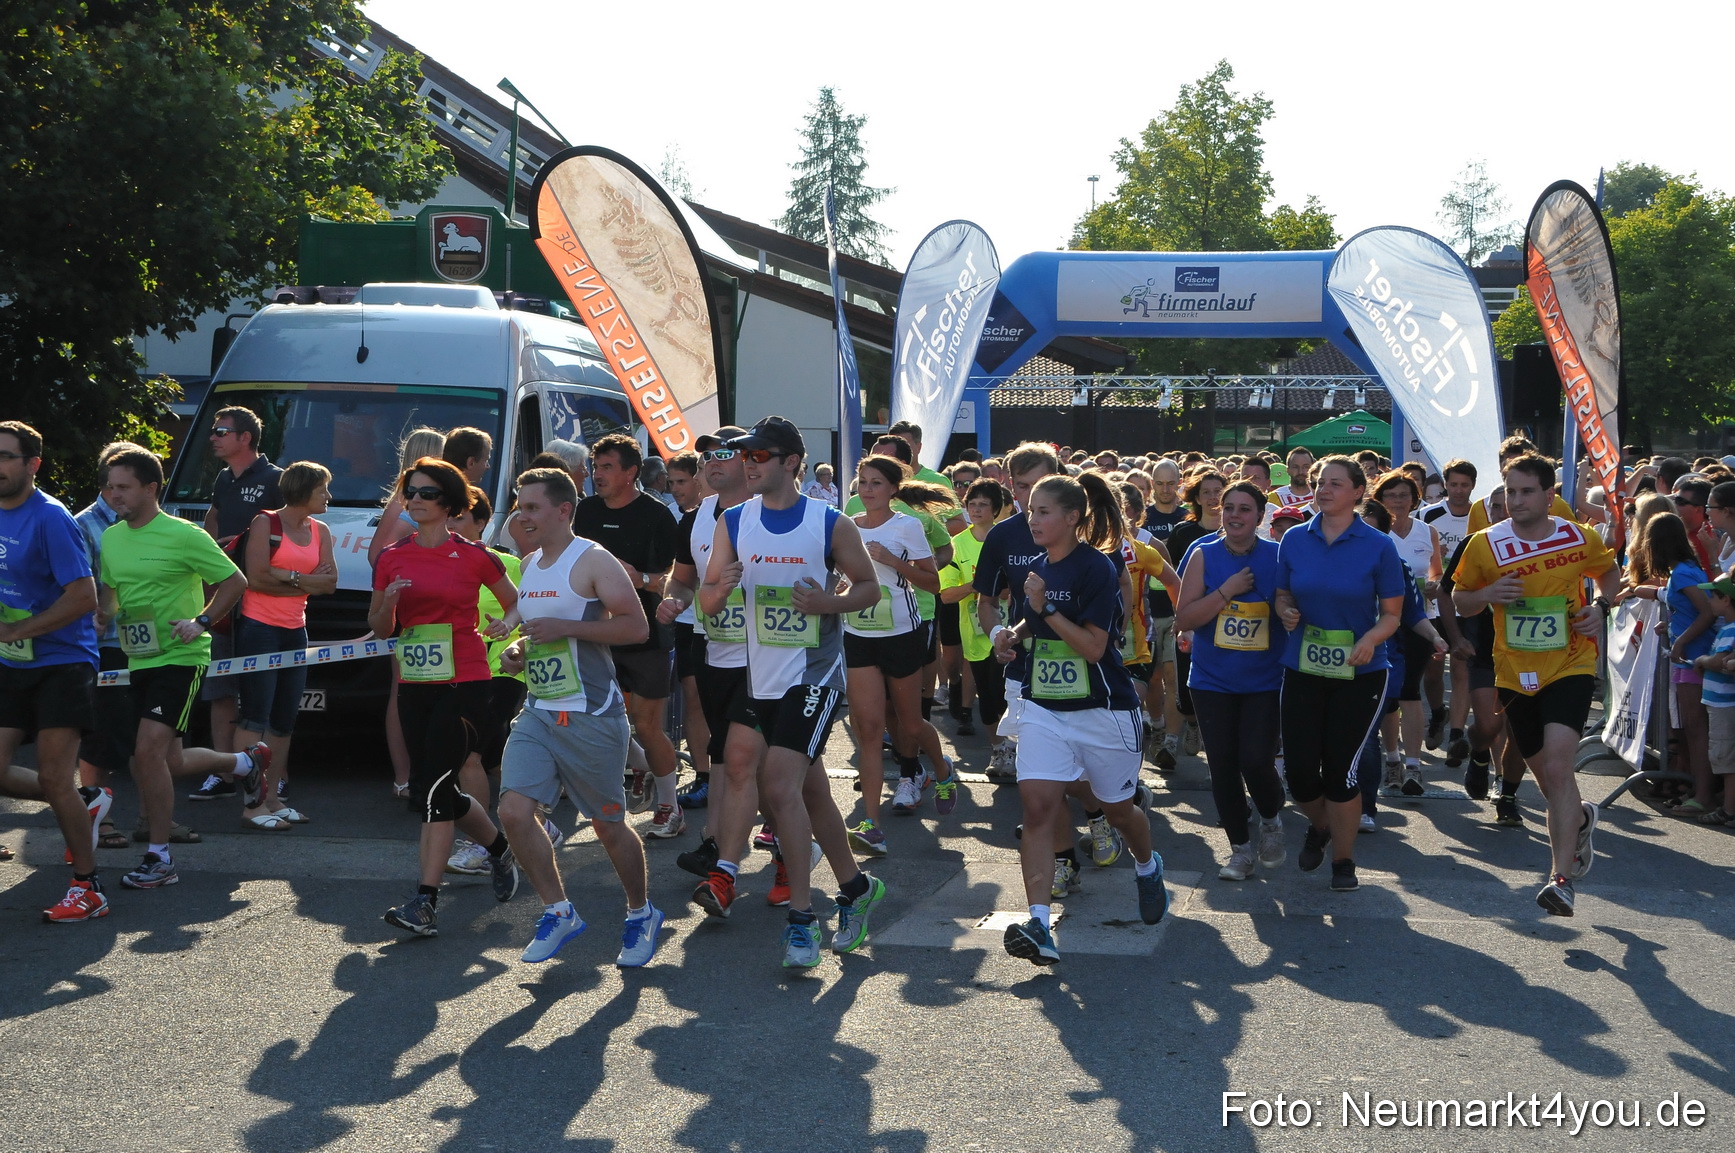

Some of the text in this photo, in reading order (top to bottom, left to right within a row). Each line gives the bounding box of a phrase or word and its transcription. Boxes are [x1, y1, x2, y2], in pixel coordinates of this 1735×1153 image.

[448, 266, 472, 276] 1628
[1158, 293, 1257, 311] firmenlauf
[916, 250, 977, 382] Fischer
[765, 555, 807, 565] KLEBL
[1544, 551, 1588, 570] BÖGL
[528, 590, 560, 598] KLEBL
[764, 607, 807, 632] 523
[1224, 617, 1262, 638] 667
[1512, 615, 1557, 638] 773
[121, 624, 152, 645] 738
[404, 645, 443, 667] 595
[1307, 643, 1345, 667] 689
[528, 657, 566, 684] 532
[1038, 660, 1078, 684] 326
